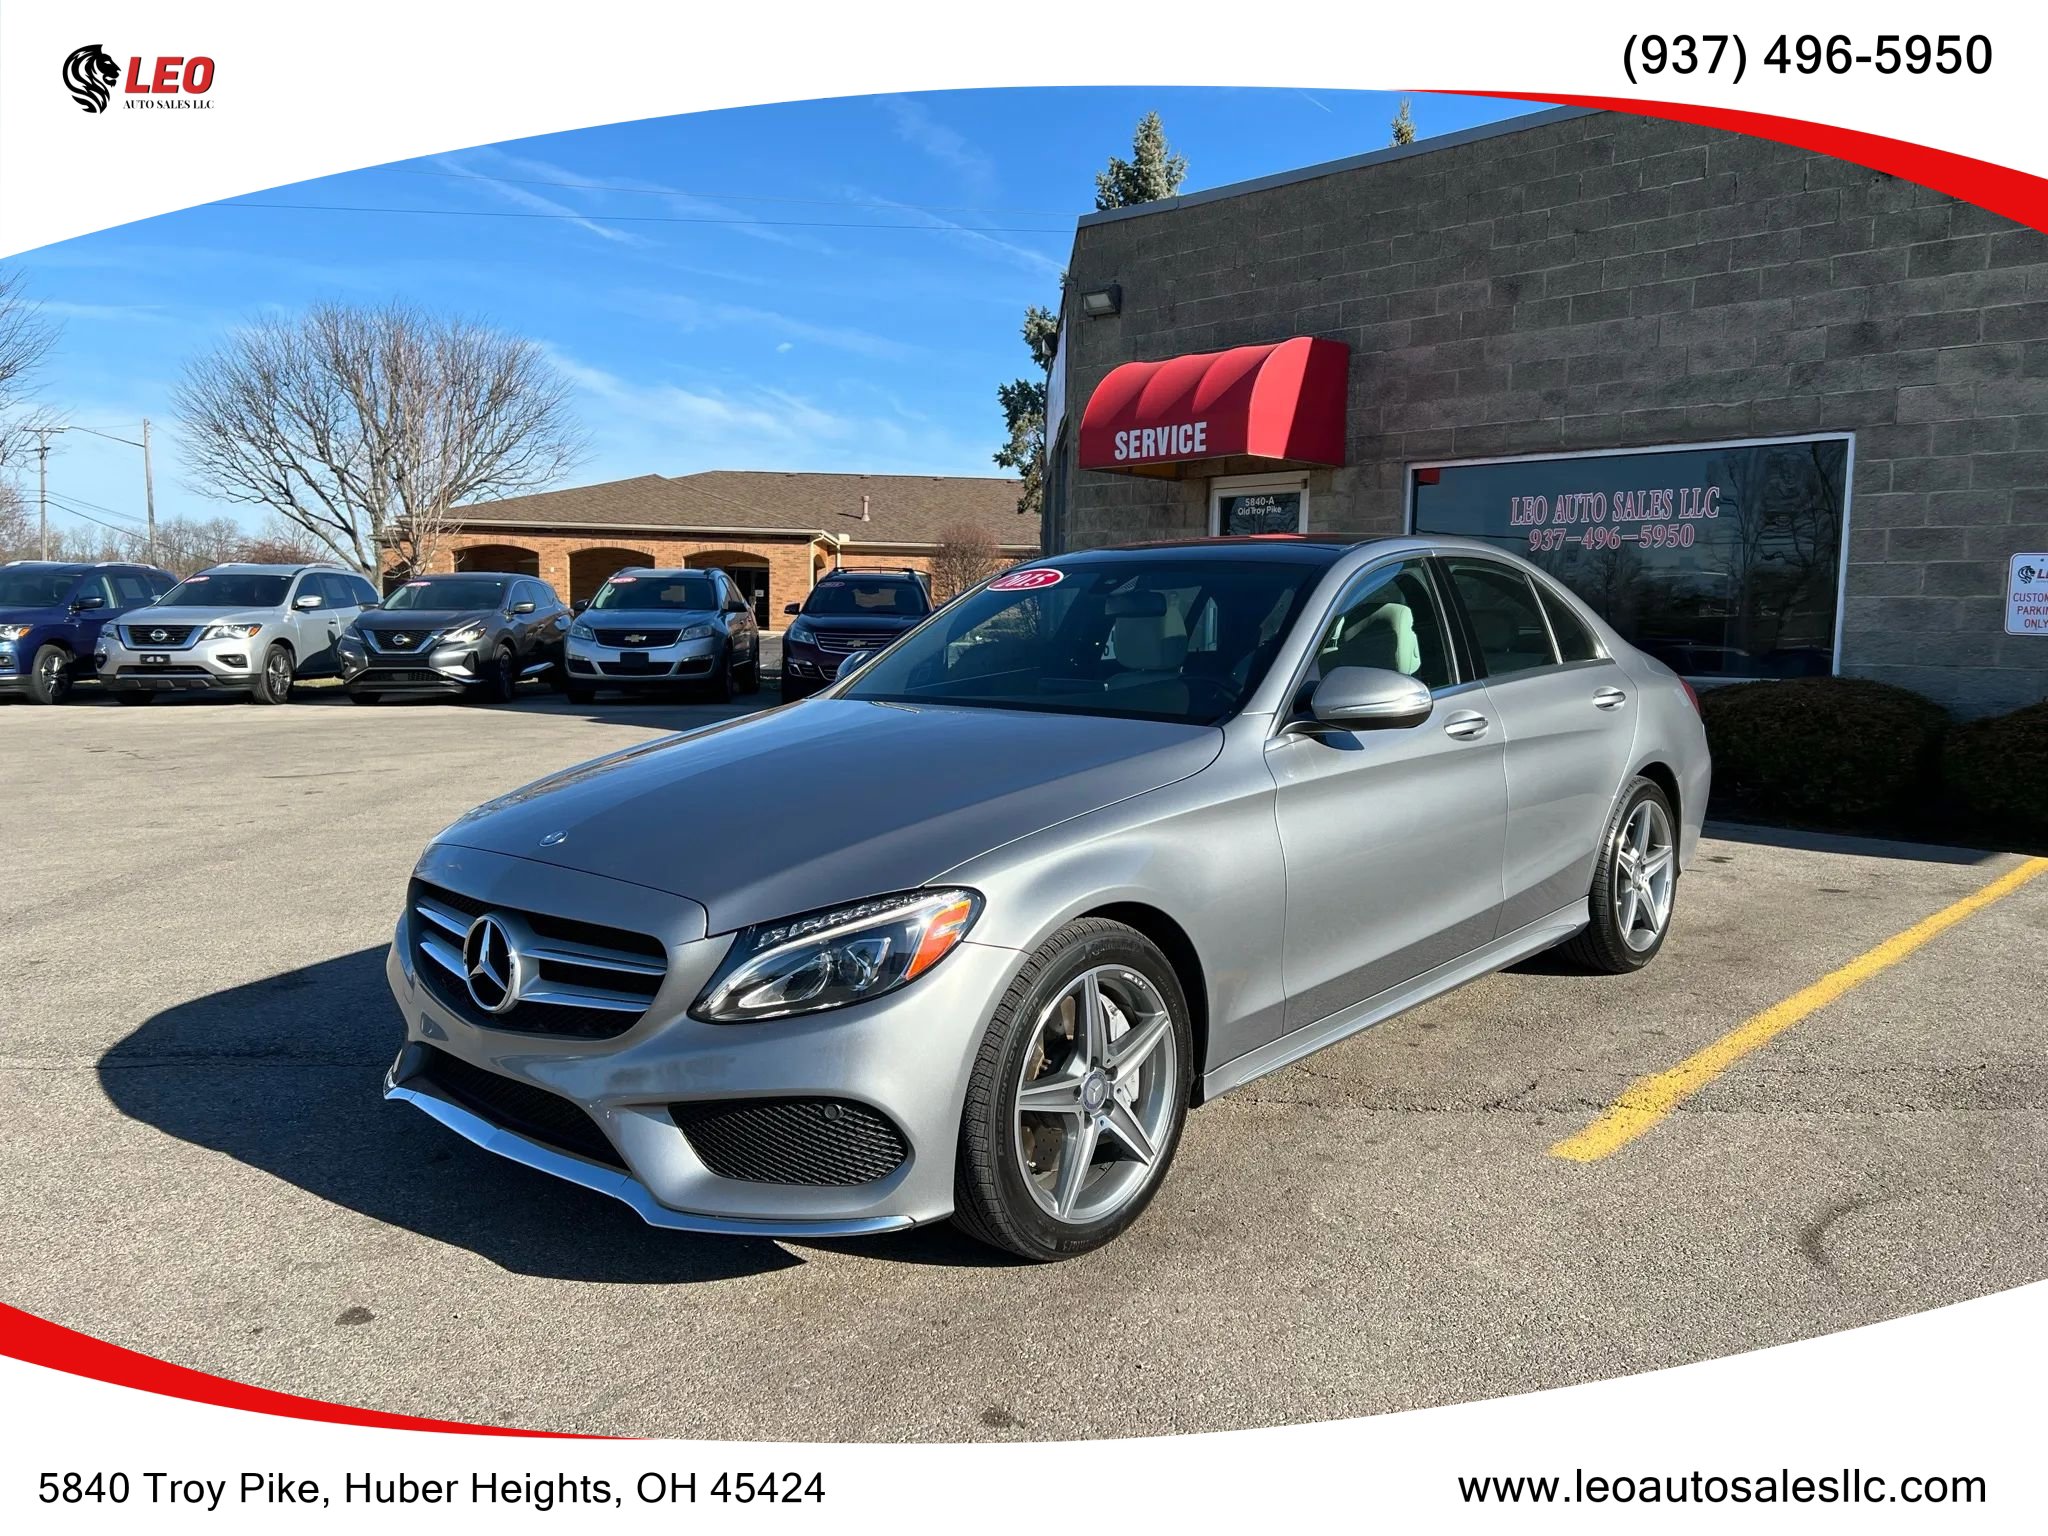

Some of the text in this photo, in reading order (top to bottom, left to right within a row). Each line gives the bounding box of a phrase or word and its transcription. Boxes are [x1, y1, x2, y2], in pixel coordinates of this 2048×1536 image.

[1114, 421, 1208, 461] SERVICE
[1237, 506, 1282, 516] Old Troy Pike
[1245, 496, 1275, 507] 5840-A
[1510, 486, 1720, 526] LEO AUTO SALES LLC
[1529, 524, 1695, 551] 937-496-5950
[2024, 618, 2048, 629] ONLY
